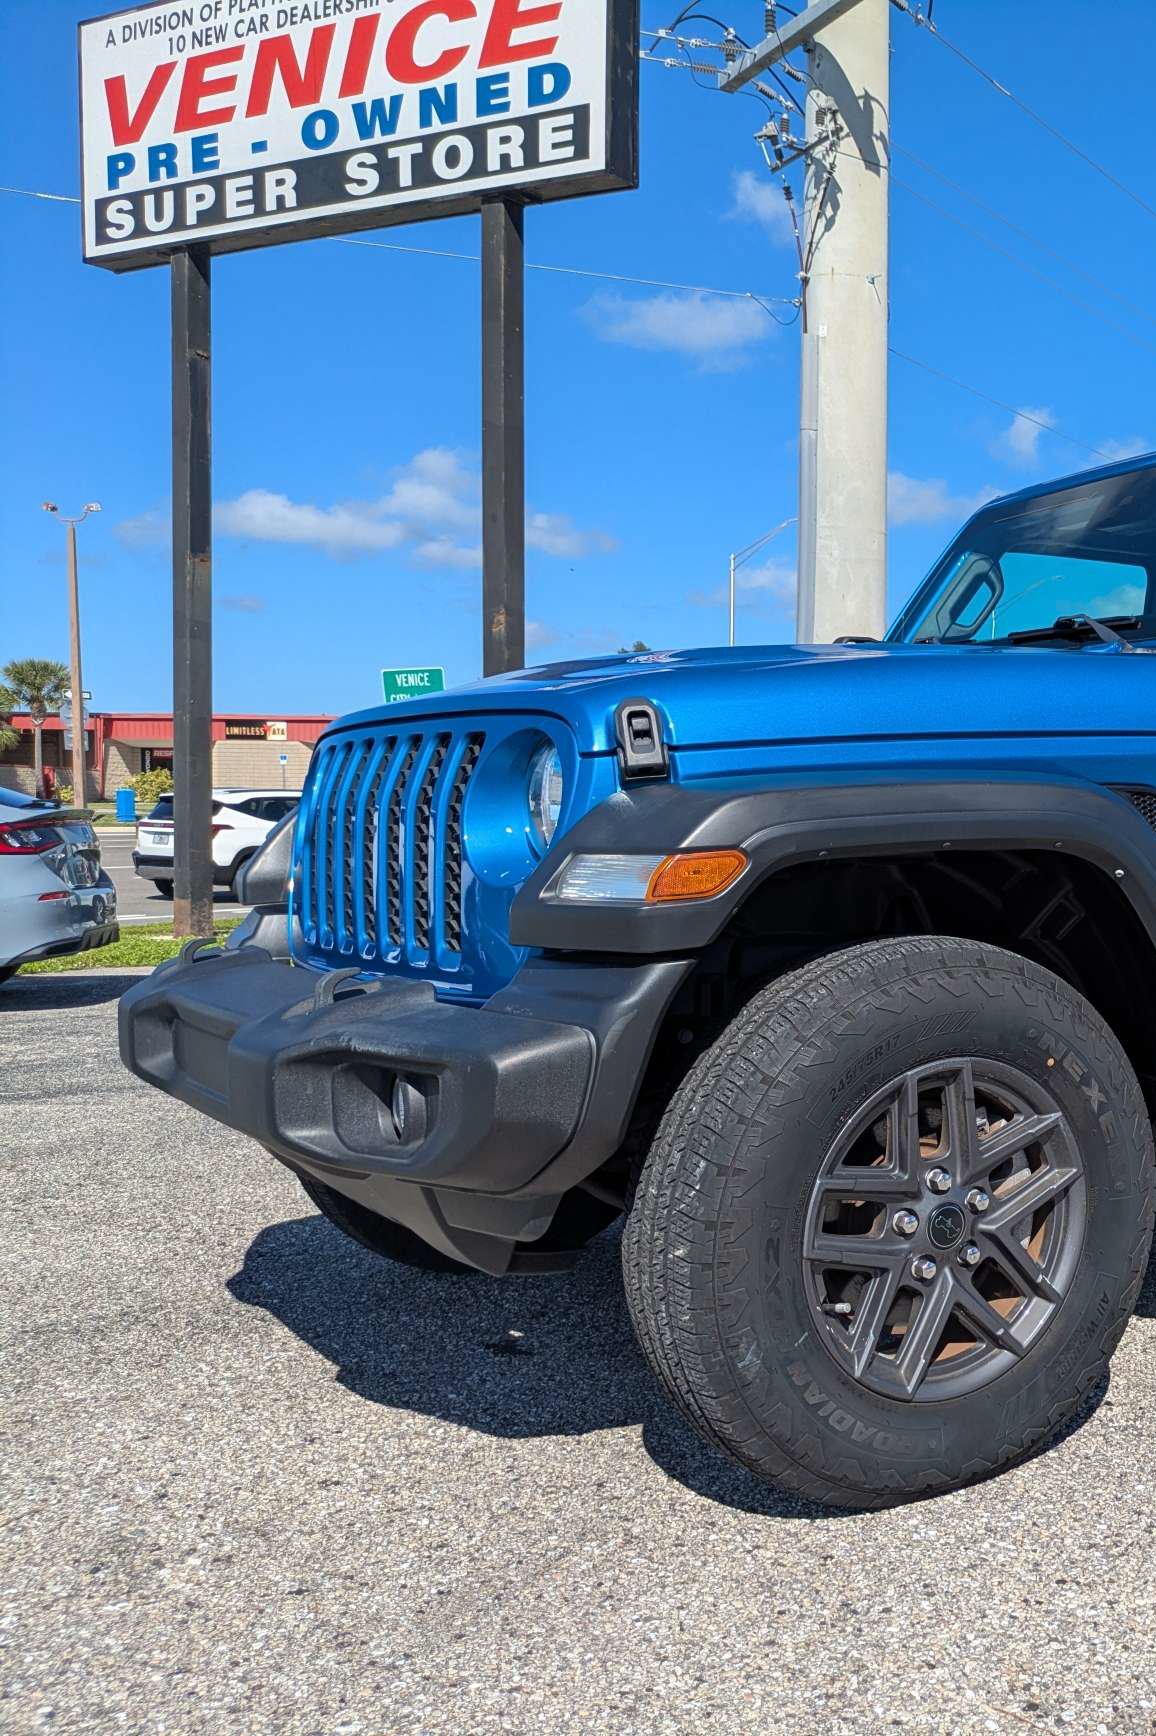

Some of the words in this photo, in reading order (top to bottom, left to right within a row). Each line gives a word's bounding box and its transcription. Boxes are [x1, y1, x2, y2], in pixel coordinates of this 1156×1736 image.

[105, 29, 117, 48] A
[122, 8, 194, 44] DIVISION
[200, 1, 222, 23] OF
[168, 34, 186, 55] 10
[191, 22, 229, 49] NEW
[234, 13, 270, 39] CAR
[104, 0, 568, 148] VENICE
[105, 168, 298, 239] SUPER
[344, 114, 577, 197] STORE
[395, 672, 431, 687] VENICE
[225, 726, 265, 736] LIMITLESS
